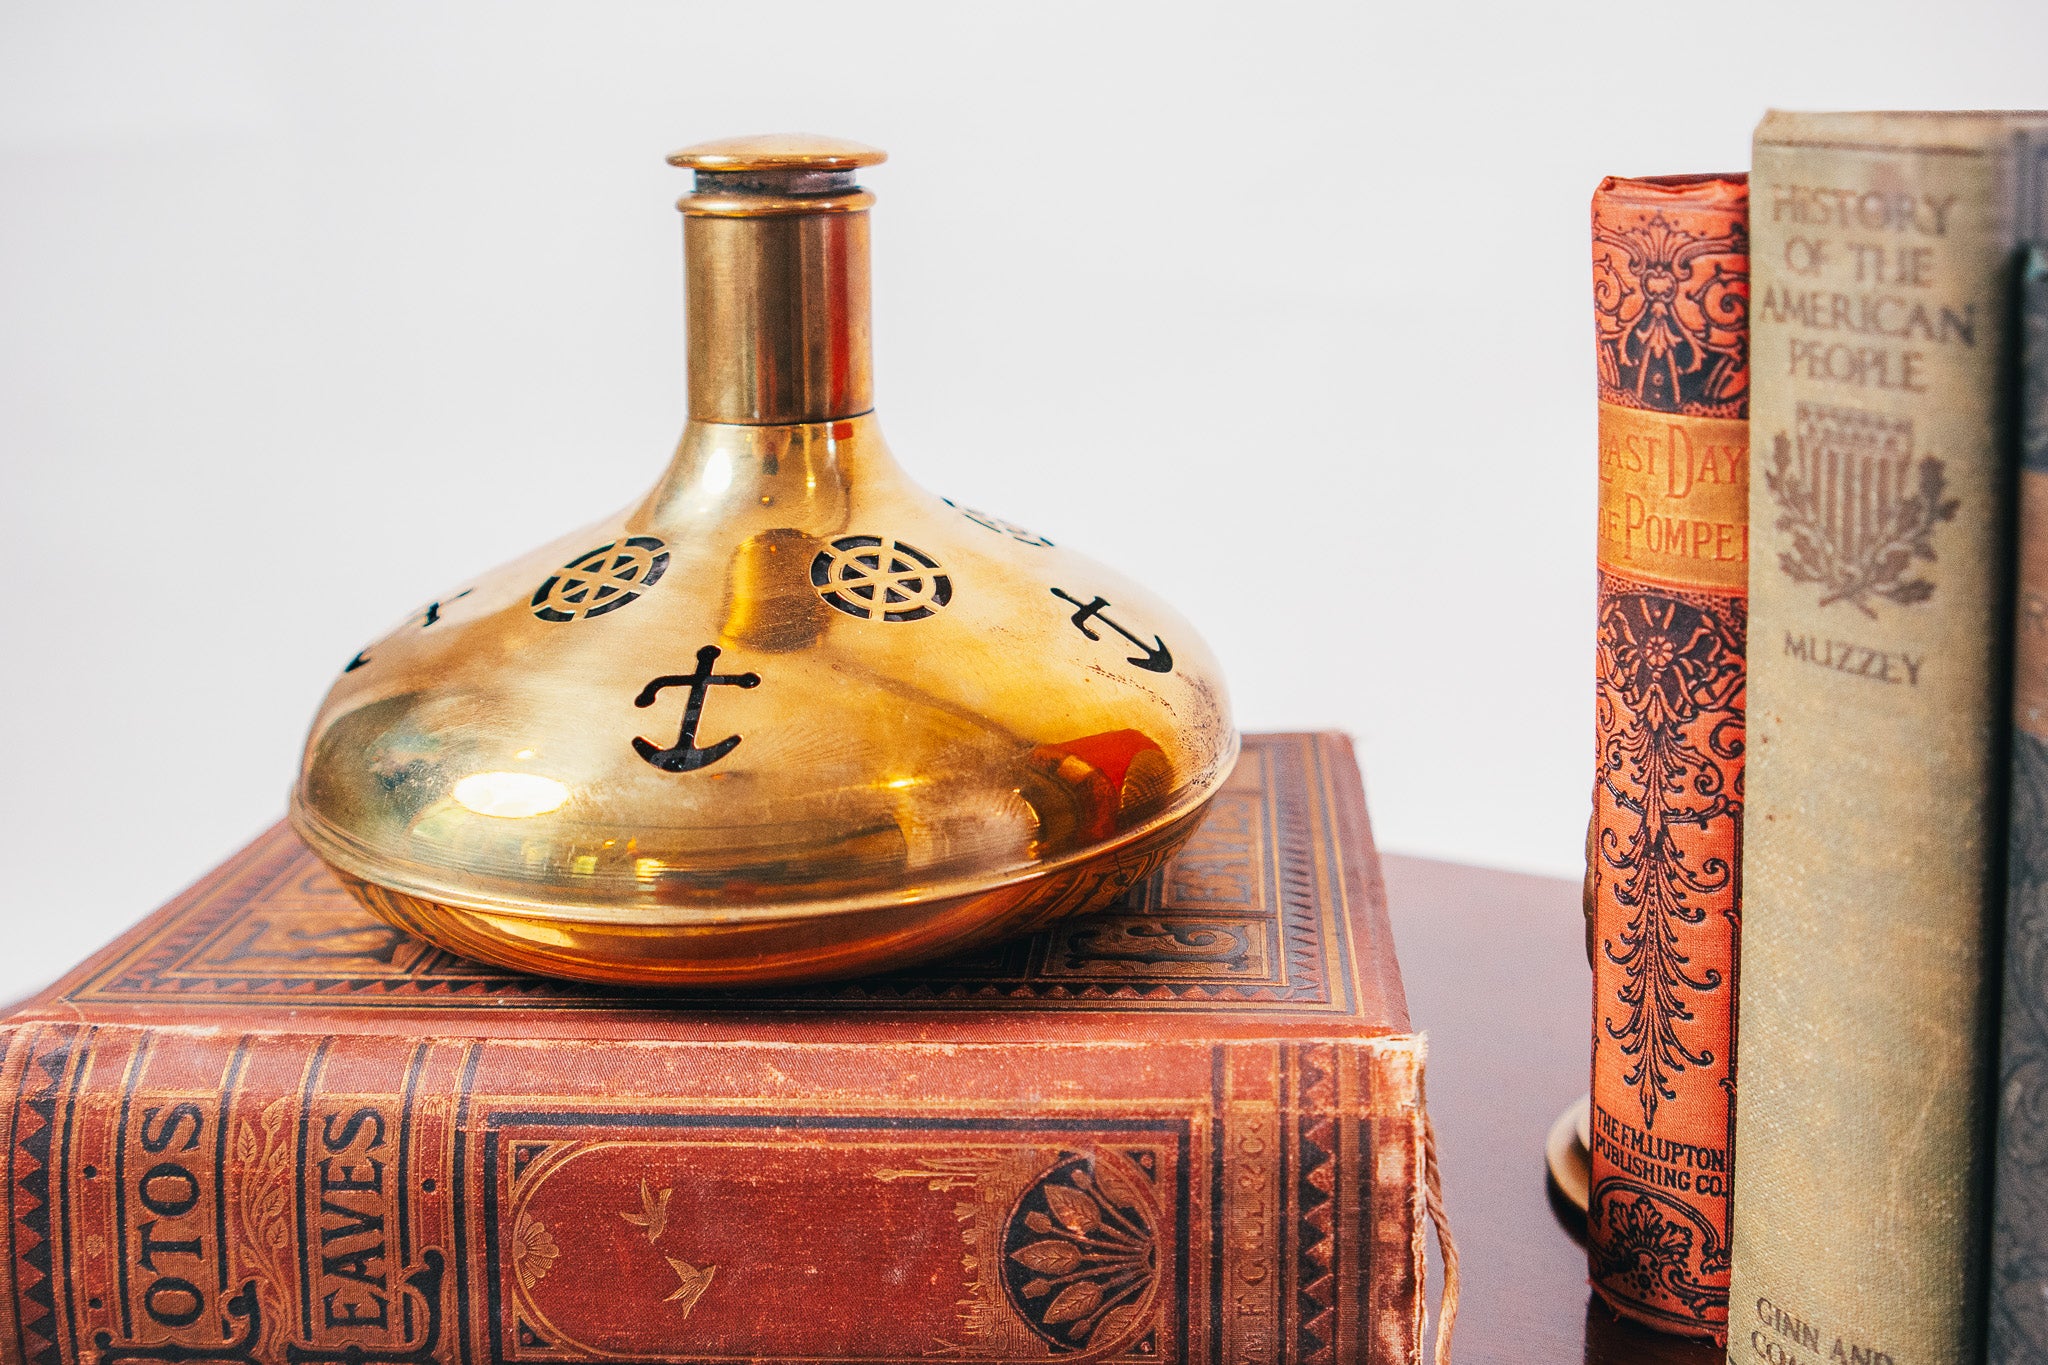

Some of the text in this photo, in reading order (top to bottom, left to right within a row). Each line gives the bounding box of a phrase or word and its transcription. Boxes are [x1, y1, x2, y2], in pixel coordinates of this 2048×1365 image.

[1772, 182, 1958, 238] HISTORY
[1783, 234, 1934, 289] OF THE
[1758, 284, 1979, 346] AMERICAN
[1788, 336, 1929, 394] PEOPLE
[1784, 628, 1926, 687] MUZZEY
[1596, 1104, 1620, 1142] THE
[1595, 1132, 1728, 1199] PUBLISHING CO.
[1756, 1297, 1820, 1355] GINN
